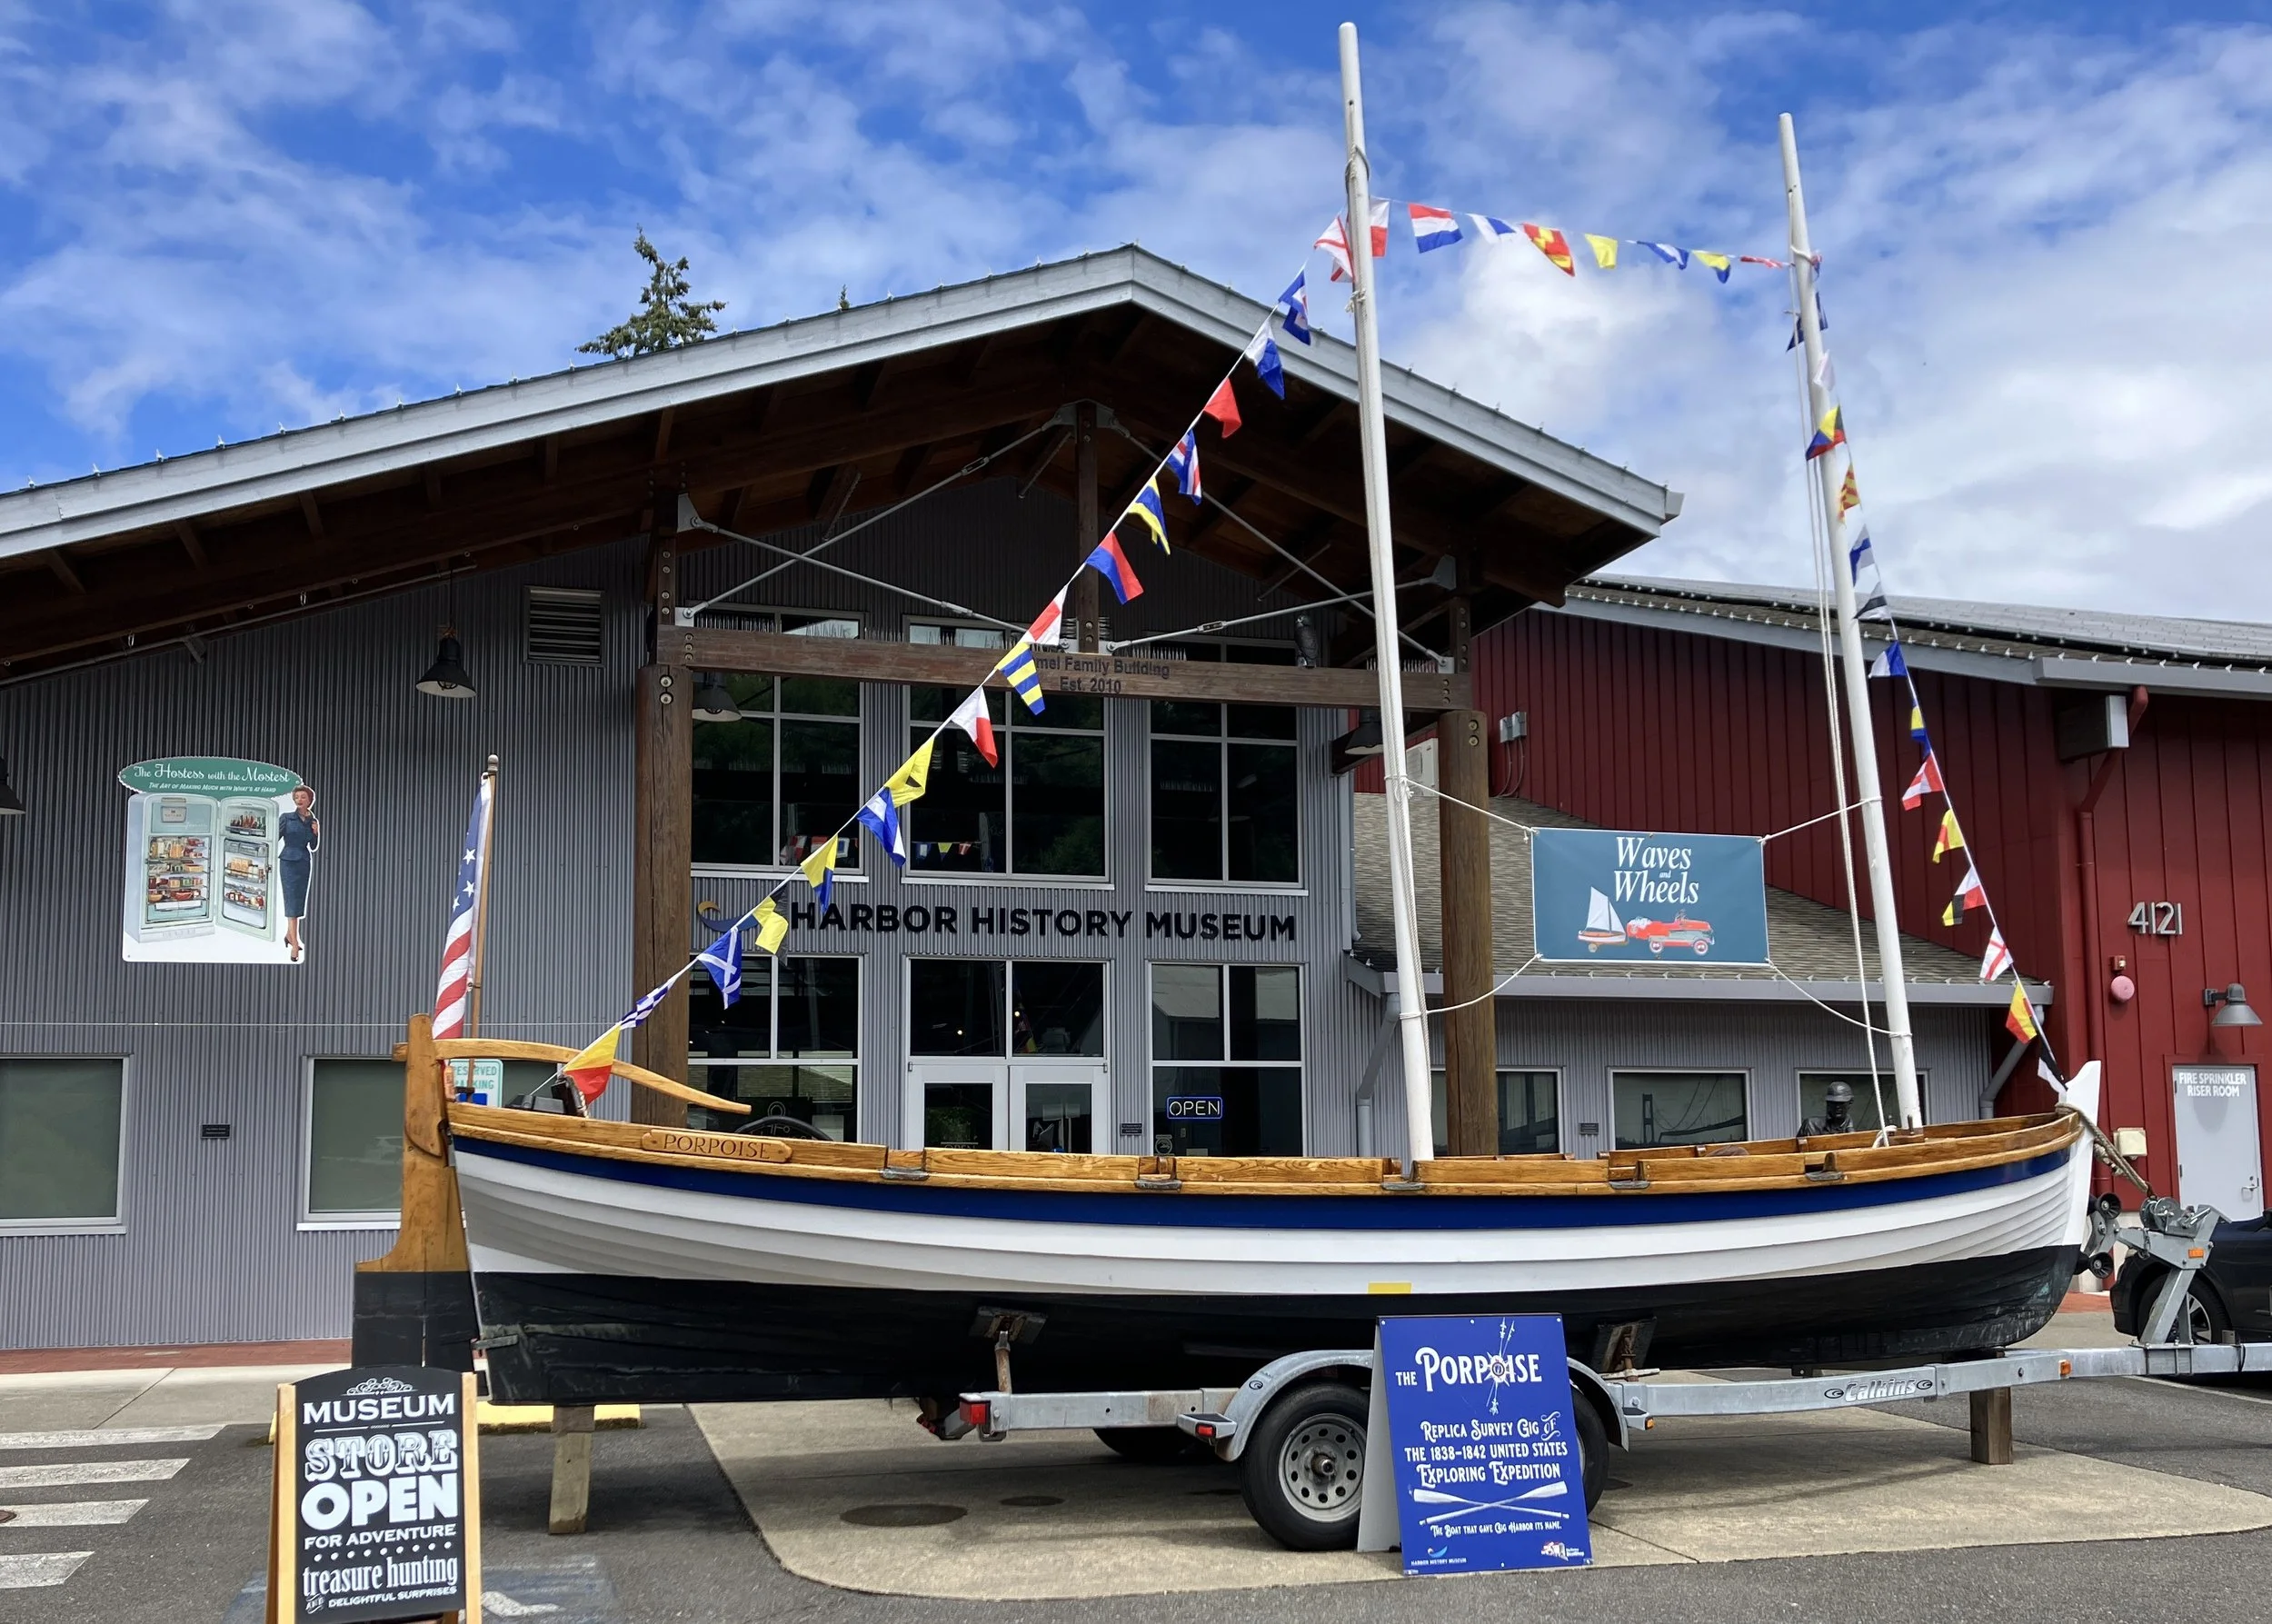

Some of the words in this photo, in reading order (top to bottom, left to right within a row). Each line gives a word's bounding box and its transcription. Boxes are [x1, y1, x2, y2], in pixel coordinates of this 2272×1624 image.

[1035, 656, 1061, 670] mel
[1064, 655, 1110, 675] Family
[1114, 658, 1171, 680] Building
[1060, 675, 1085, 691] Est.
[1090, 677, 1121, 692] 2010
[133, 765, 152, 777] The
[154, 763, 204, 779] Hostess
[208, 772, 225, 781] with
[227, 772, 241, 781] the
[242, 766, 291, 782] Mostest
[1617, 836, 1692, 870] Waves
[1614, 870, 1699, 903] Wheels
[792, 902, 958, 934] HARBOR
[972, 907, 1132, 938] HISTORY
[1145, 911, 1297, 942] MUSEUM
[2127, 902, 2183, 935] 4121
[453, 1065, 497, 1076] ESRVED
[2179, 1072, 2197, 1084] FIRE
[2199, 1072, 2247, 1085] SPRINKLER
[455, 1080, 494, 1090] AKING
[2187, 1086, 2211, 1097] RISER
[2213, 1086, 2240, 1097] ROOM
[1169, 1100, 1220, 1116] OPEN
[663, 1133, 772, 1161] PORPOISE
[1396, 1371, 1418, 1386] THE
[1415, 1346, 1542, 1391] PORPOISE
[1845, 1377, 1917, 1402] Calkins
[302, 1393, 455, 1425] MUSEUM
[1420, 1420, 1467, 1443] REPLICA
[1470, 1419, 1513, 1440] SURVEY
[1517, 1418, 1540, 1437] GIG
[304, 1429, 458, 1482] STORE
[1404, 1447, 1427, 1462] THE
[1430, 1444, 1487, 1460] 1838-1842
[1490, 1443, 1529, 1459] UNITED
[1531, 1441, 1568, 1457] STATES
[1416, 1464, 1486, 1489] EXPLORING
[1489, 1461, 1561, 1486] EXPEDITION
[301, 1473, 459, 1530] OPEN
[304, 1534, 343, 1549] FOR
[345, 1524, 456, 1546] ADVENTURE
[1444, 1524, 1461, 1538] BOAT
[1463, 1526, 1477, 1534] THAT
[1479, 1525, 1493, 1534] GAVE
[1508, 1521, 1534, 1534] HARBOR
[1535, 1521, 1544, 1530] ITS
[303, 1566, 383, 1597] treasure
[386, 1555, 458, 1589] hunting
[328, 1594, 396, 1608] DELIGHTFUL
[397, 1586, 457, 1600] SURPRISES
